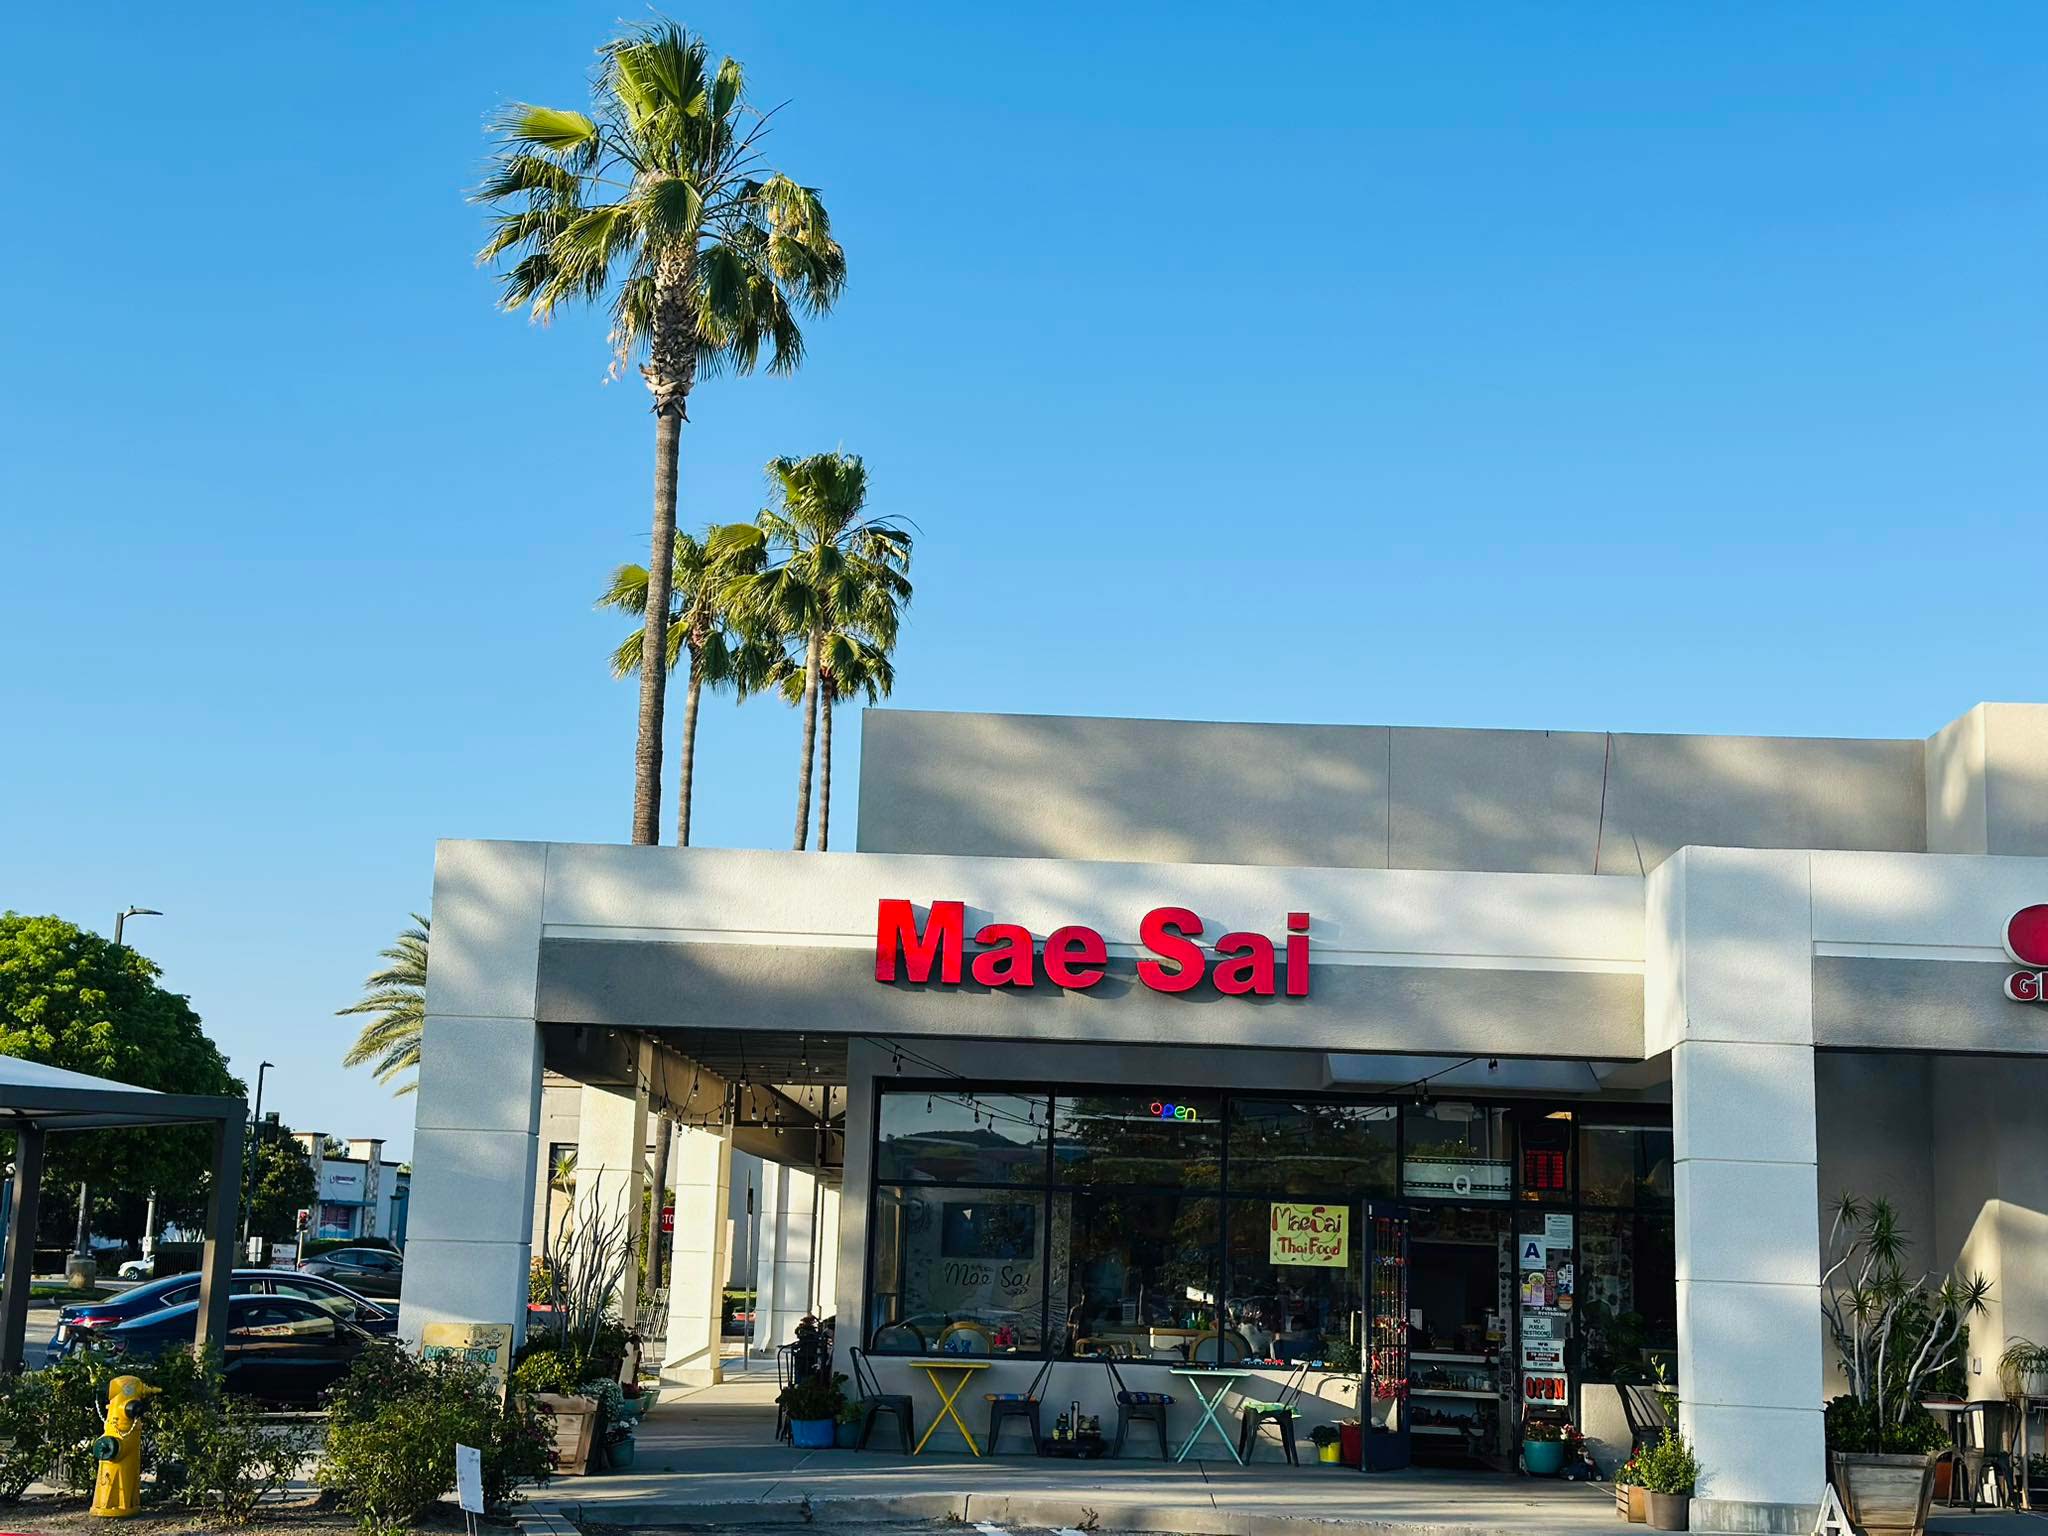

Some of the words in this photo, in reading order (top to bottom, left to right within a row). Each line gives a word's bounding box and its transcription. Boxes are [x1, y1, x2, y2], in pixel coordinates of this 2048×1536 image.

[875, 898, 1107, 988] Mae
[1136, 906, 1310, 996] Sai
[1151, 1102, 1196, 1121] open
[1524, 1242, 1540, 1258] A
[944, 1262, 993, 1287] Mae
[1000, 1265, 1031, 1289] Sai
[1525, 1376, 1566, 1400] OPEN
